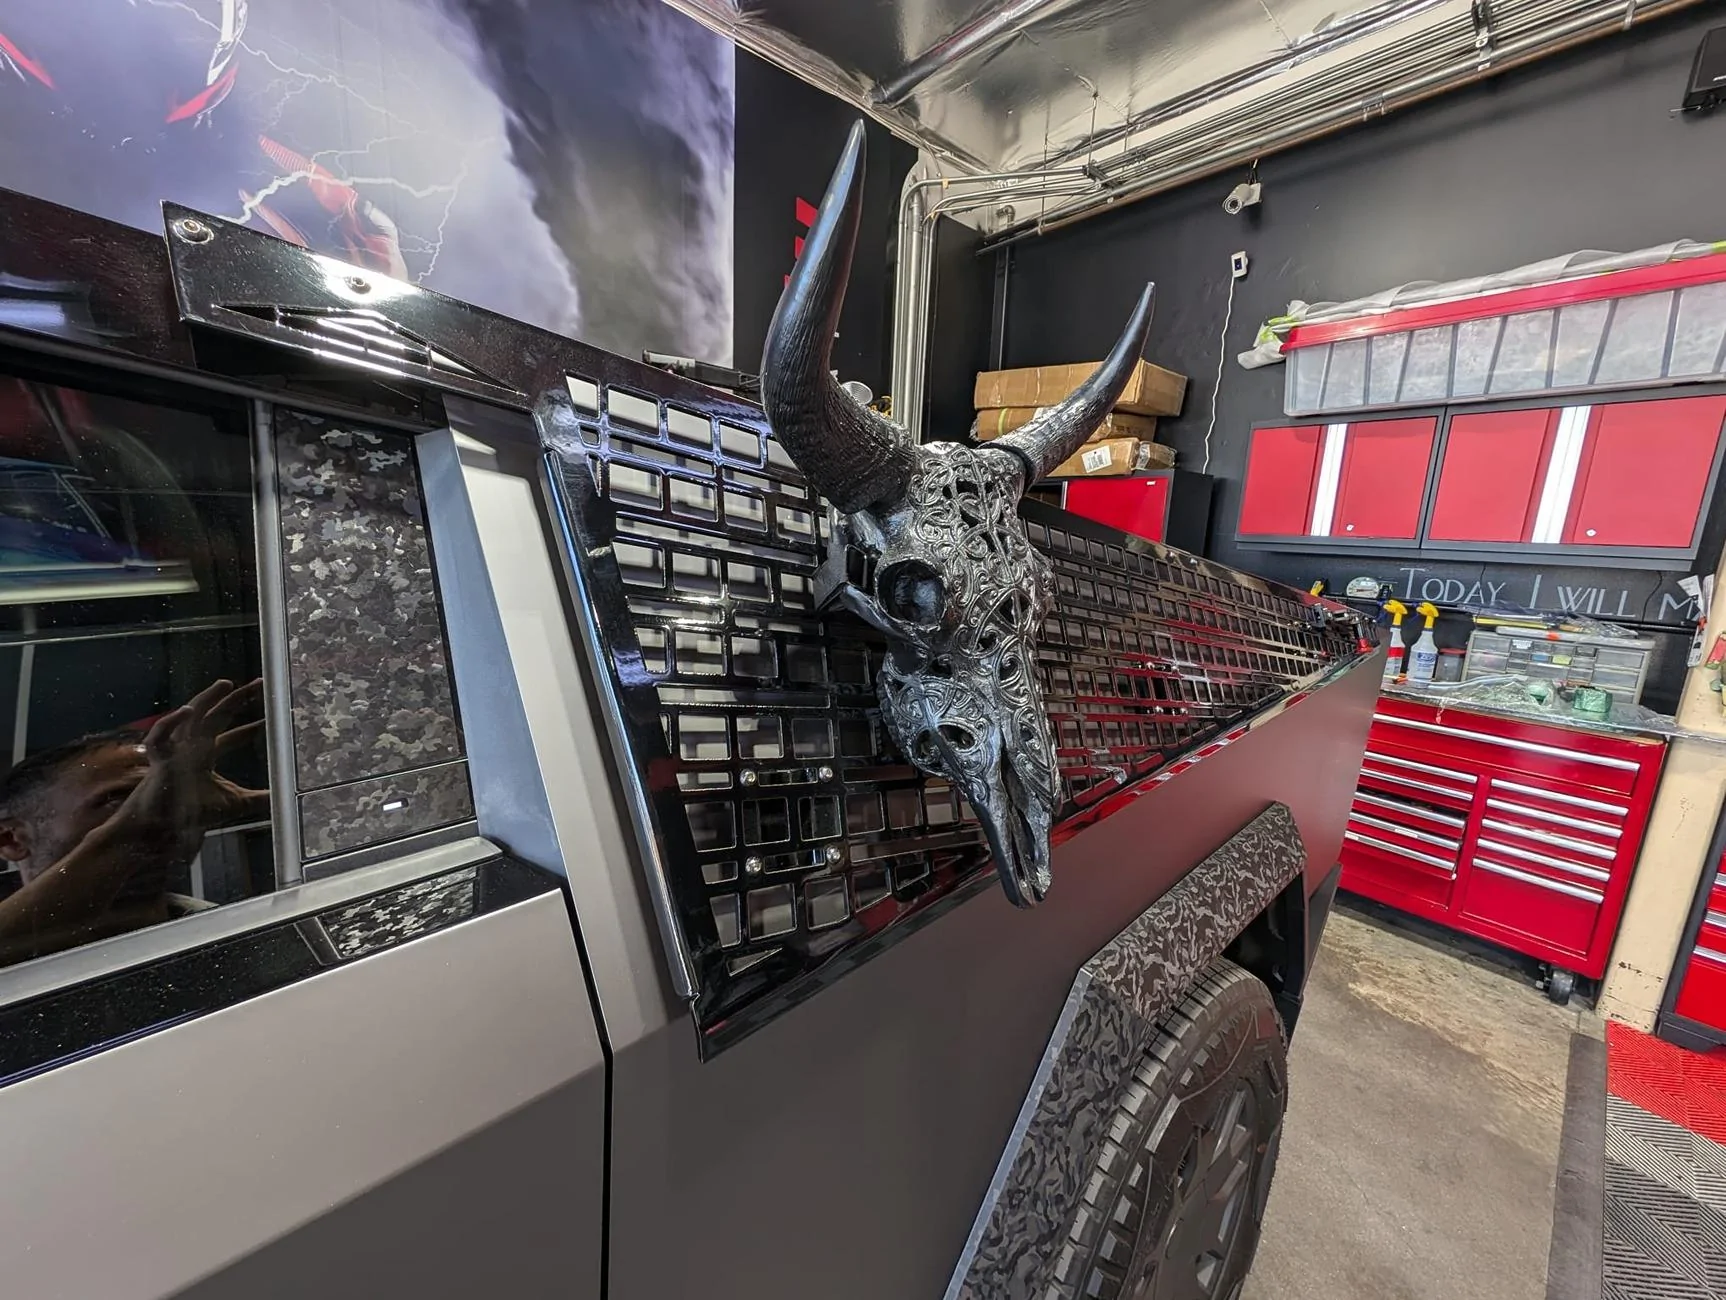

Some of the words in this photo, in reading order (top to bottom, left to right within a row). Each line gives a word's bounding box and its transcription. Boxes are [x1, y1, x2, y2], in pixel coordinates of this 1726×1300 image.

[1529, 574, 1542, 609] I
[1557, 586, 1636, 617] WILL
[1658, 593, 1701, 621] M
